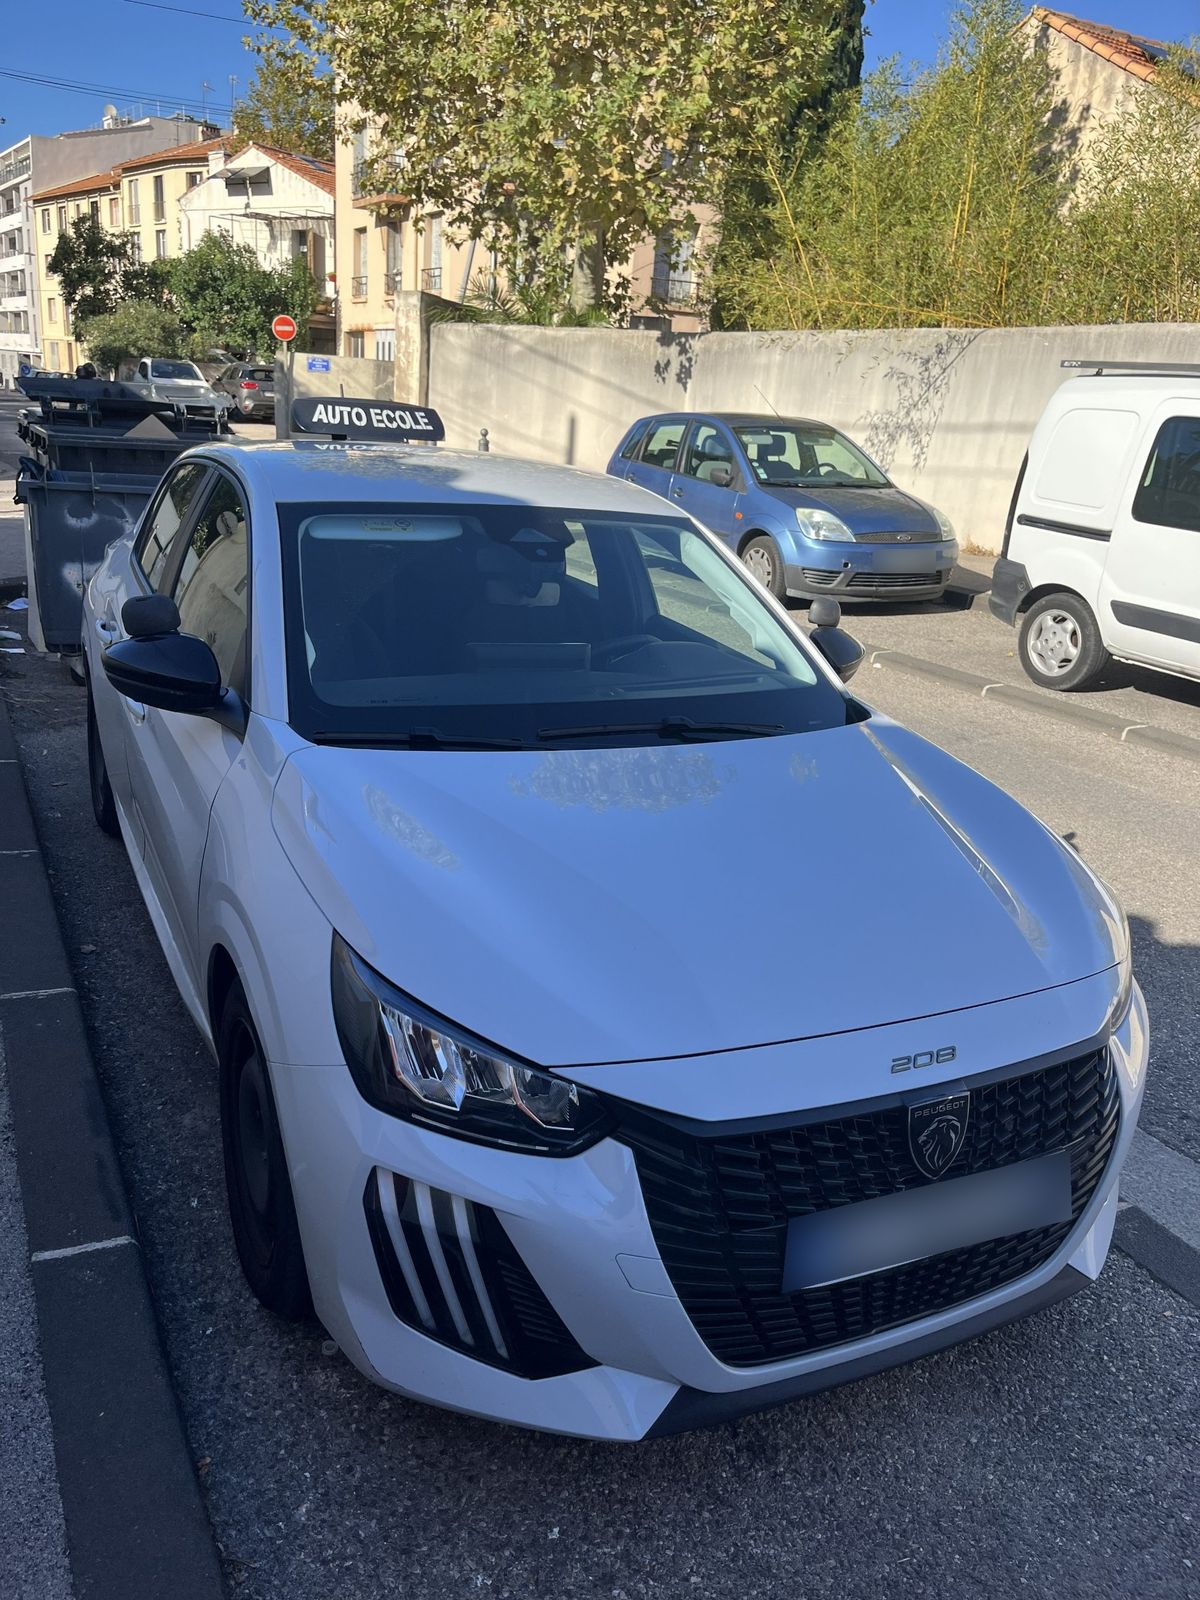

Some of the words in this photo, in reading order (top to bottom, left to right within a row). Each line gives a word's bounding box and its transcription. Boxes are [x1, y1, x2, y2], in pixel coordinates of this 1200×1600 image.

[312, 404, 367, 427] AUTO
[369, 408, 433, 430] ECOLE
[891, 1045, 956, 1074] 208
[914, 1100, 966, 1118] PEUGEOT
